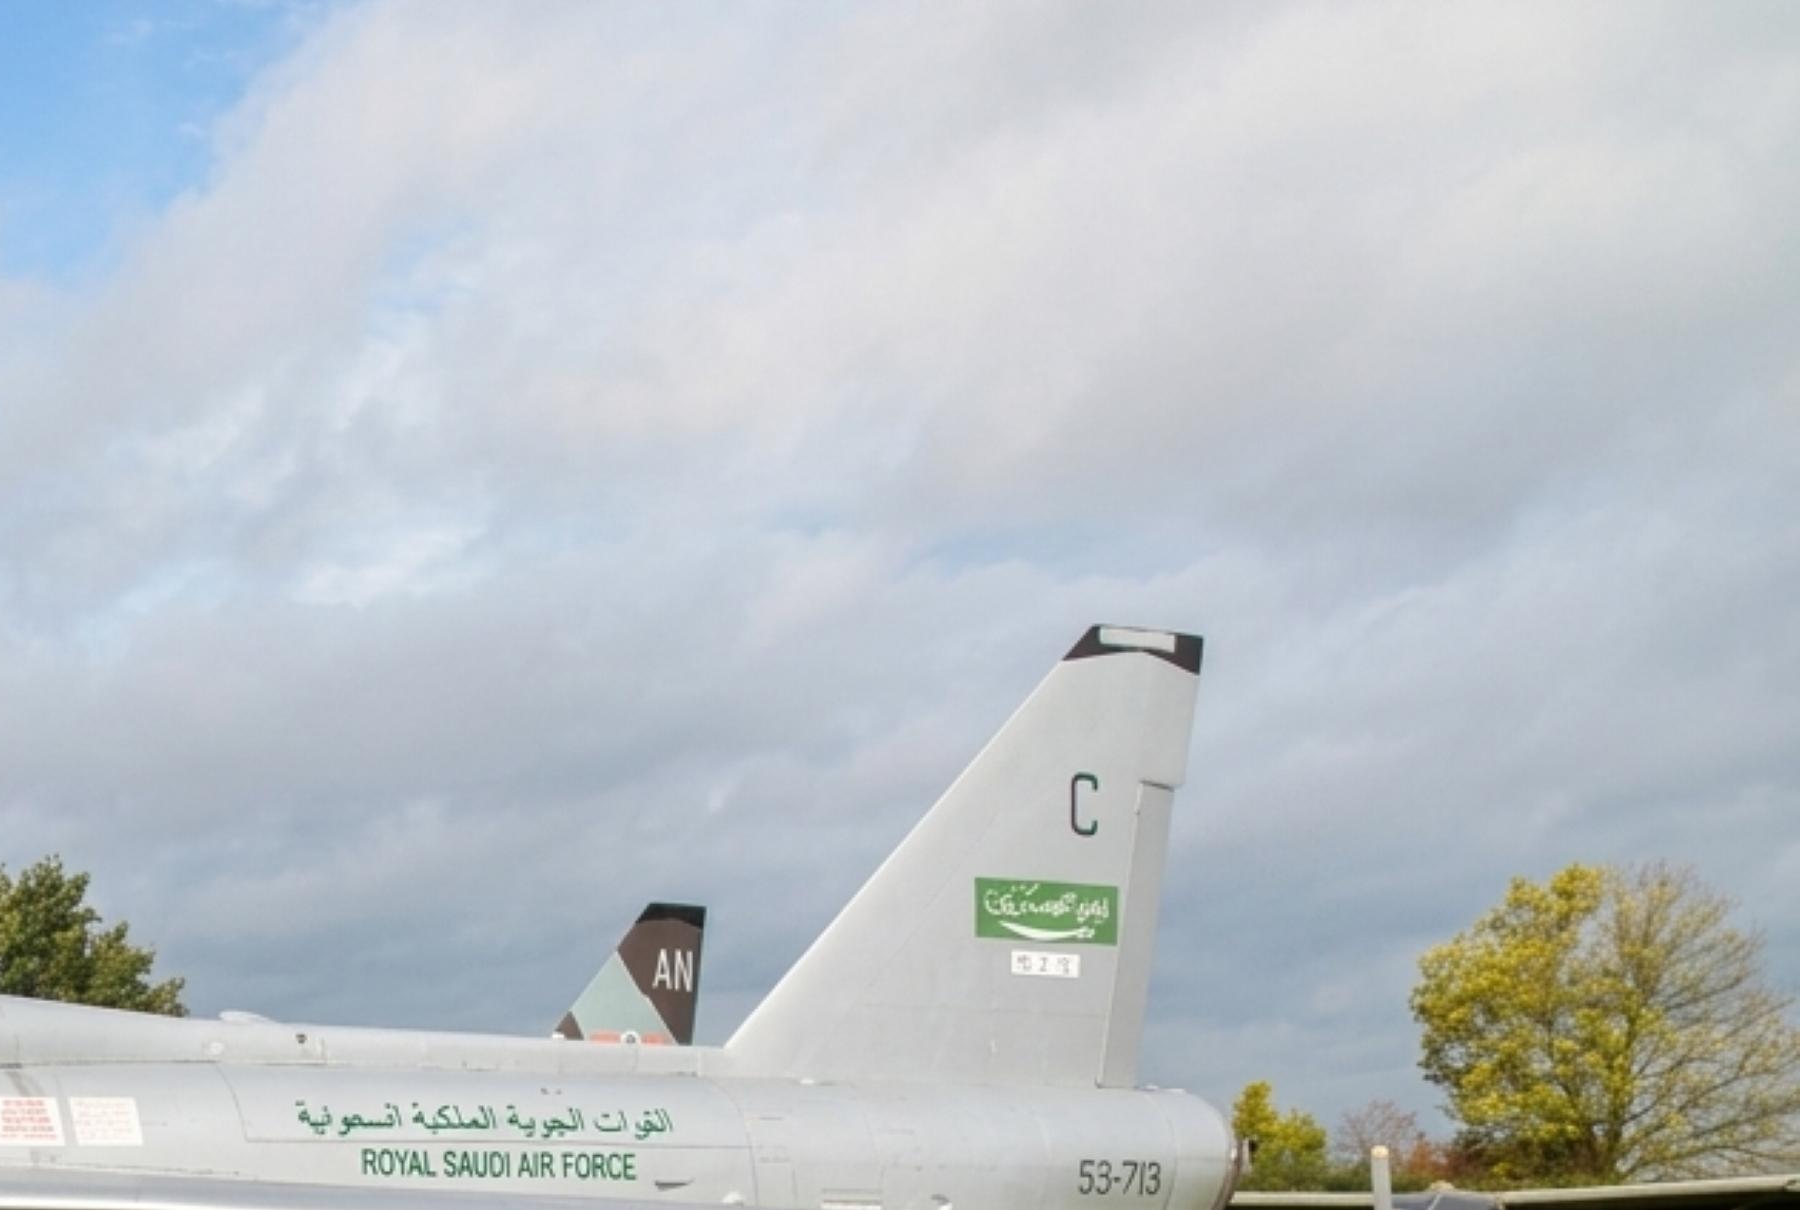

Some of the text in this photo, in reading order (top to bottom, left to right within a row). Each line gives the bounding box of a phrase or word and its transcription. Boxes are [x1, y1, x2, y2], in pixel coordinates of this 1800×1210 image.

[1071, 772, 1098, 837] C
[652, 948, 694, 993] AN
[360, 1148, 637, 1181] ROYAL SAUDI AIR FORCE
[1078, 1159, 1161, 1196] 53-713
